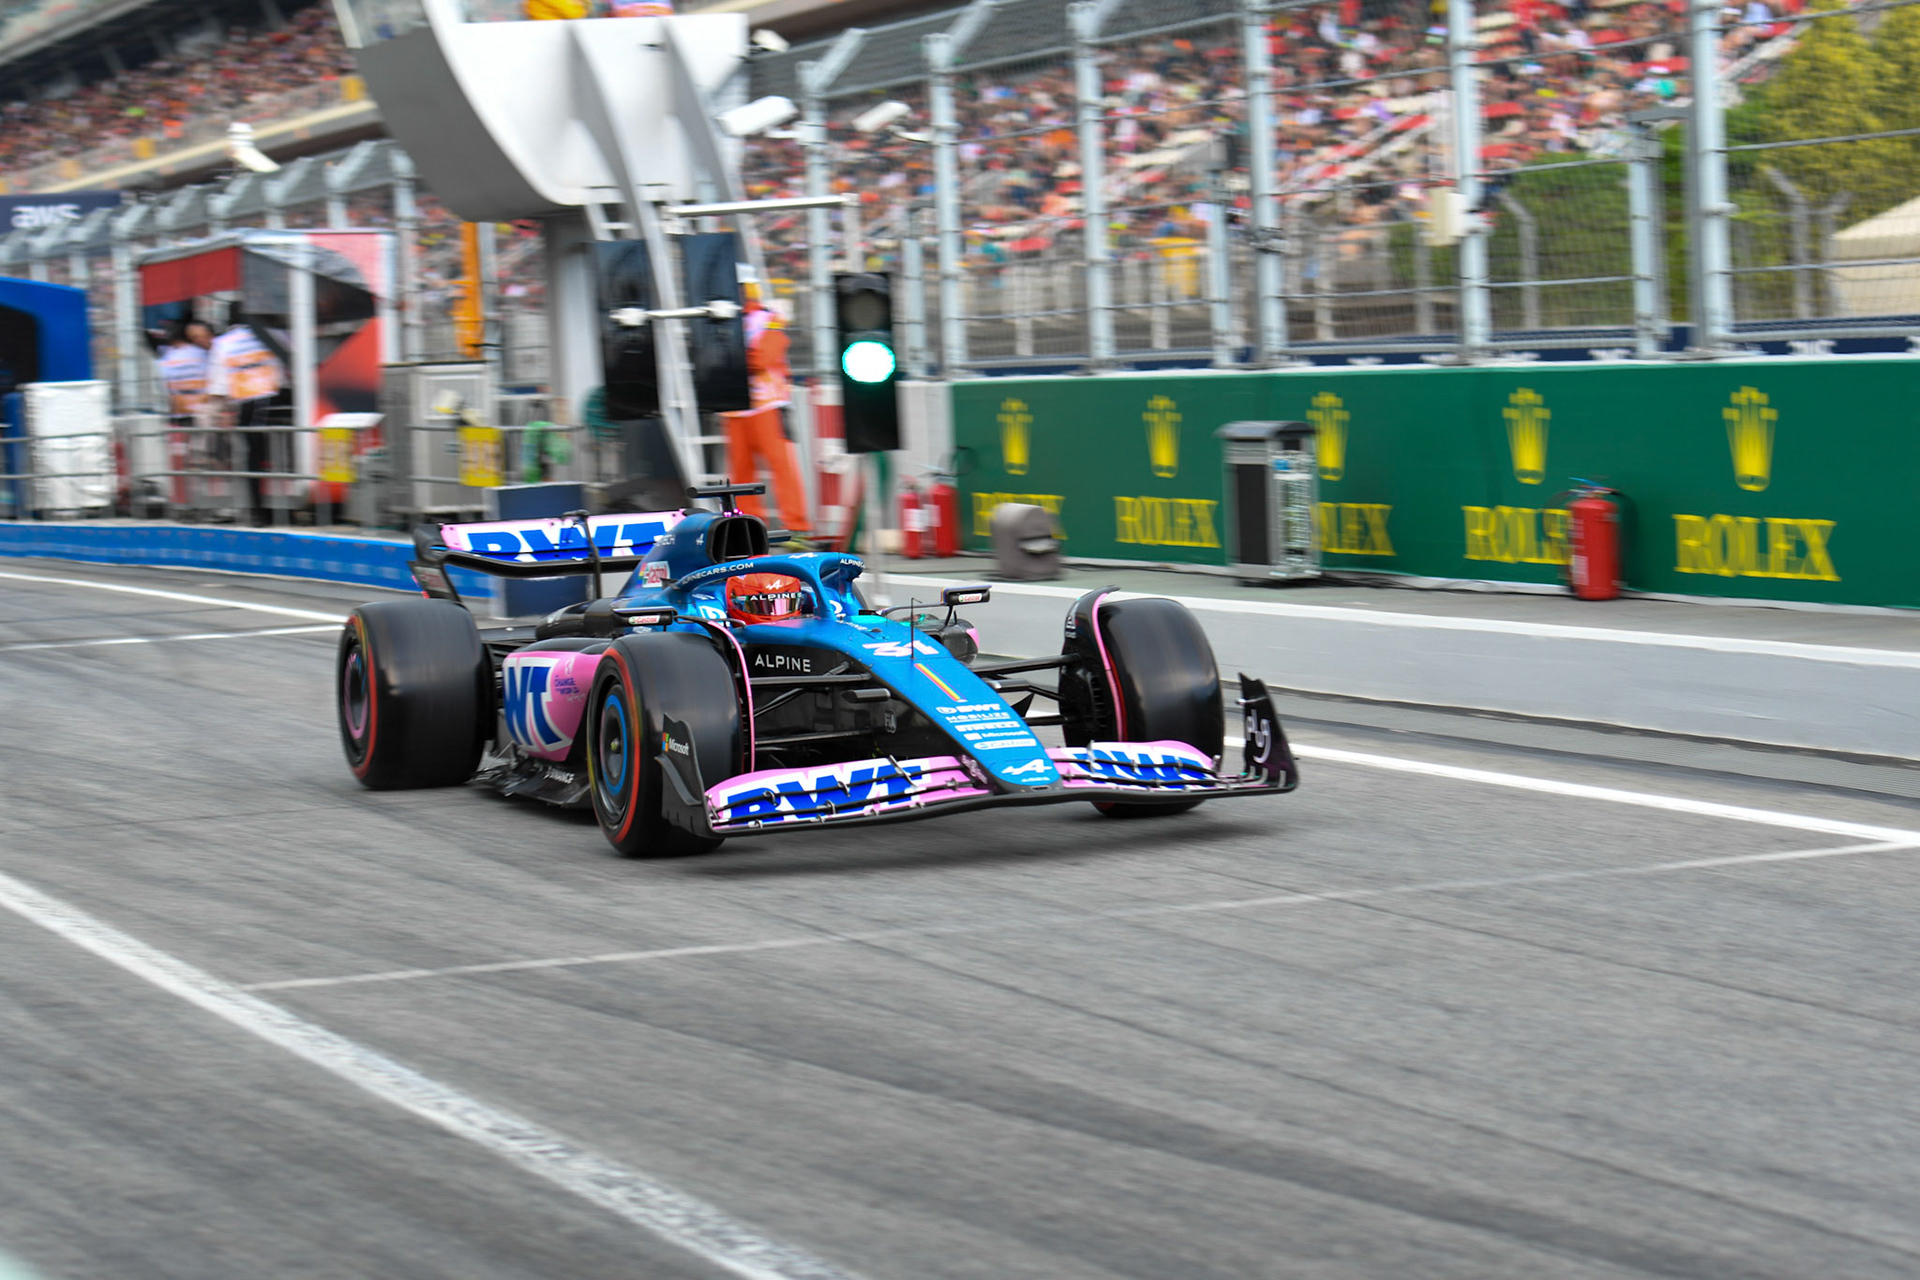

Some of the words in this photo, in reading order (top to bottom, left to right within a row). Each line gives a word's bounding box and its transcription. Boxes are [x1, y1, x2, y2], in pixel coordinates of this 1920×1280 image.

[467, 521, 667, 562] BWT
[1114, 496, 1221, 548] ROLEX
[1317, 502, 1397, 556] LEX
[1461, 505, 1572, 565] ROLE
[1673, 514, 1842, 582] ROLEX
[750, 592, 797, 602] ALPINE
[755, 653, 811, 674] ALPINE
[862, 640, 940, 657] 31
[945, 711, 1009, 722] MOBILIZE
[668, 736, 689, 755] Microsoft
[727, 765, 925, 827] BWT
